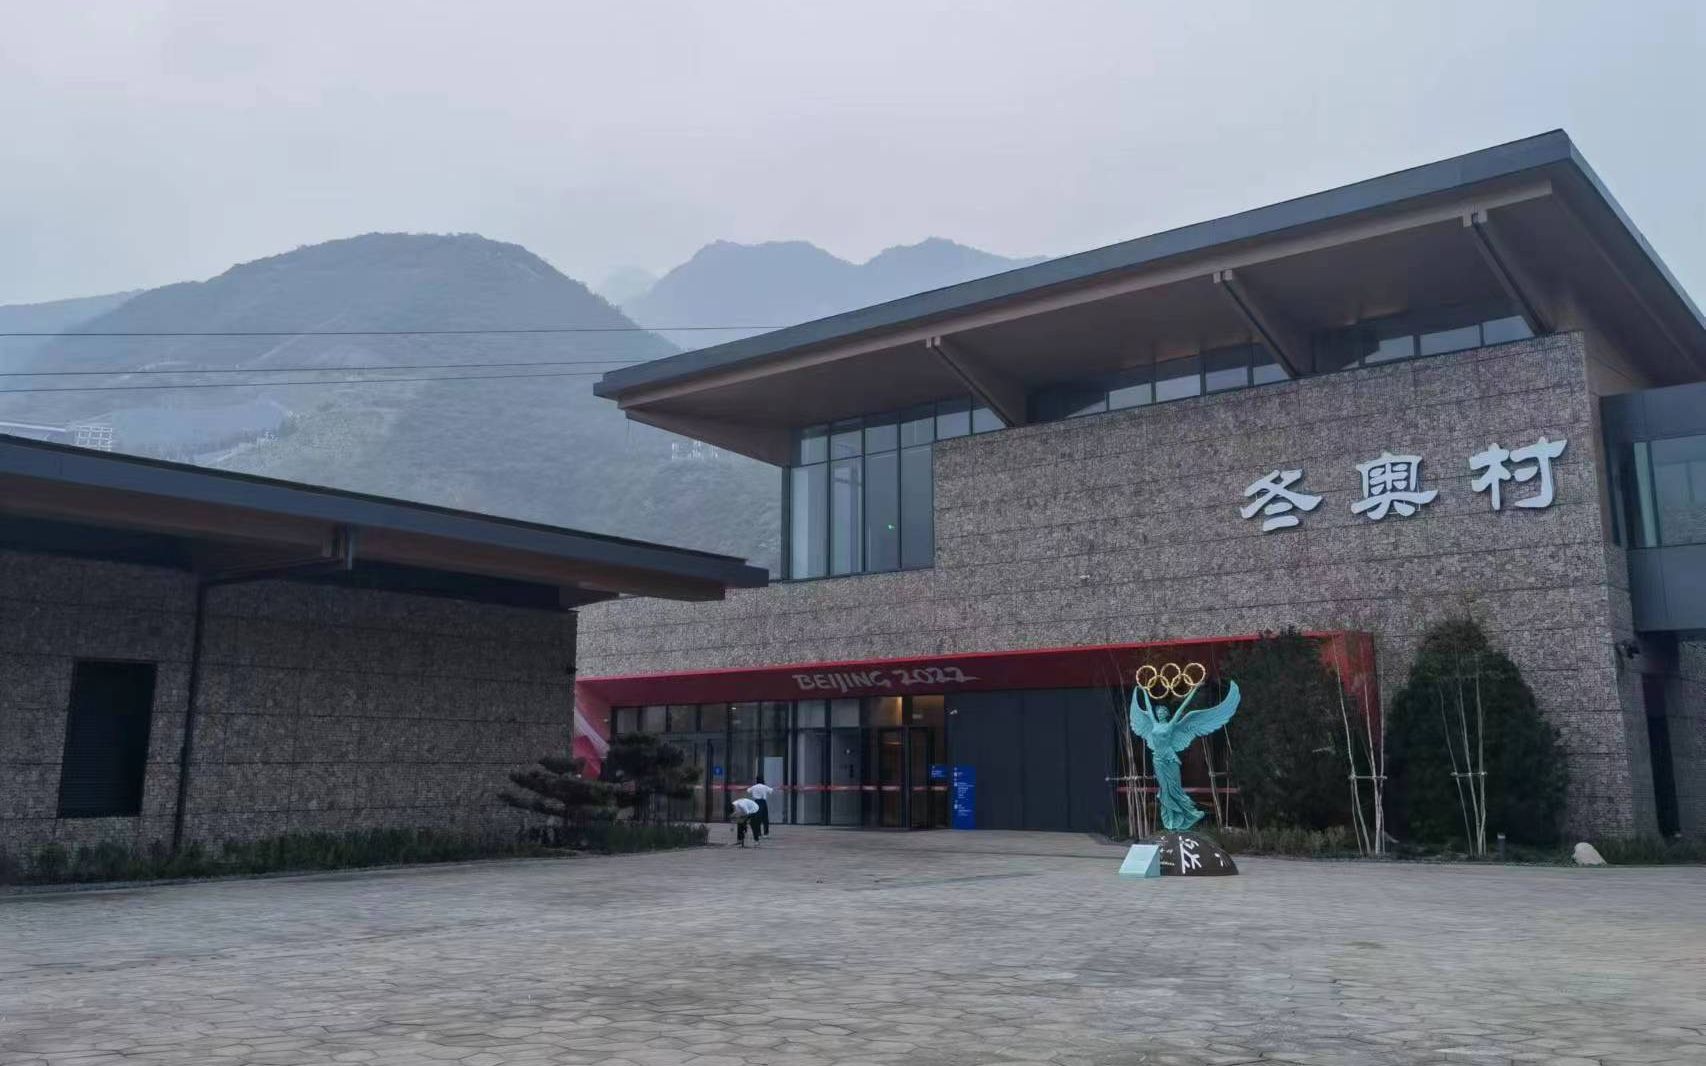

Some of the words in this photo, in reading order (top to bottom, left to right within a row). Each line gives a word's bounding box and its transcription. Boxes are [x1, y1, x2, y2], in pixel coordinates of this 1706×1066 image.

[1240, 436, 1567, 531] 冬奥村
[792, 670, 893, 693] BEIJING
[891, 666, 981, 687] 2022
